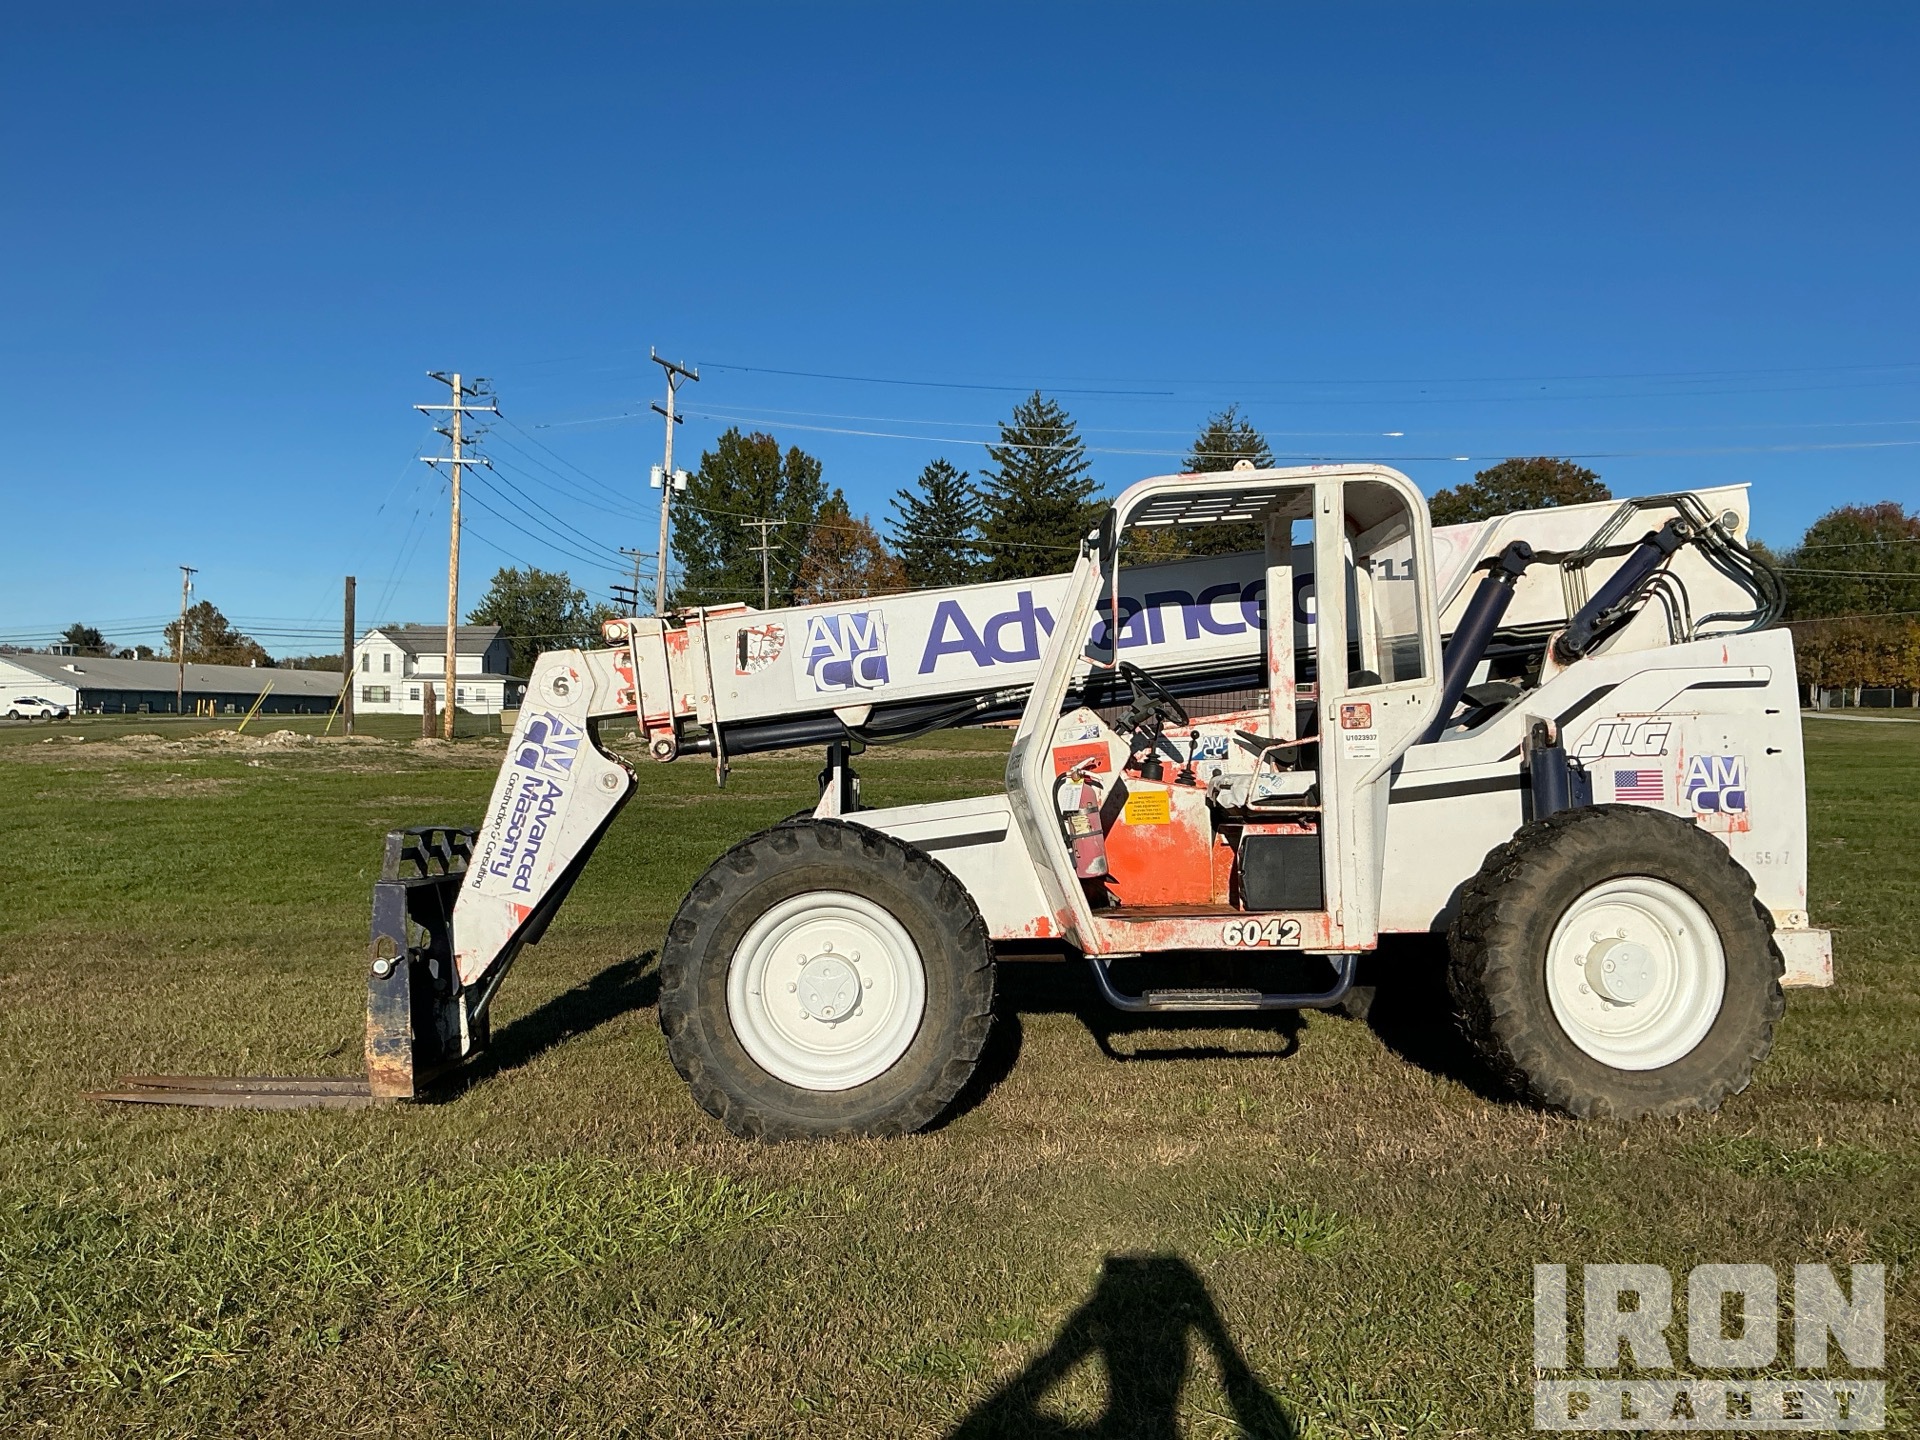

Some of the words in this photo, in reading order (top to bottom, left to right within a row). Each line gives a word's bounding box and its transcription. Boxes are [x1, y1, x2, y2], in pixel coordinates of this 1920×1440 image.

[552, 676, 570, 697] 6
[1577, 722, 1672, 758] JLG
[494, 772, 520, 831] Construction
[489, 775, 544, 878] Masonry
[512, 780, 563, 892] Advanced
[472, 841, 497, 889] Consulting
[1755, 851, 1790, 865] 557
[1222, 918, 1302, 947] 6042
